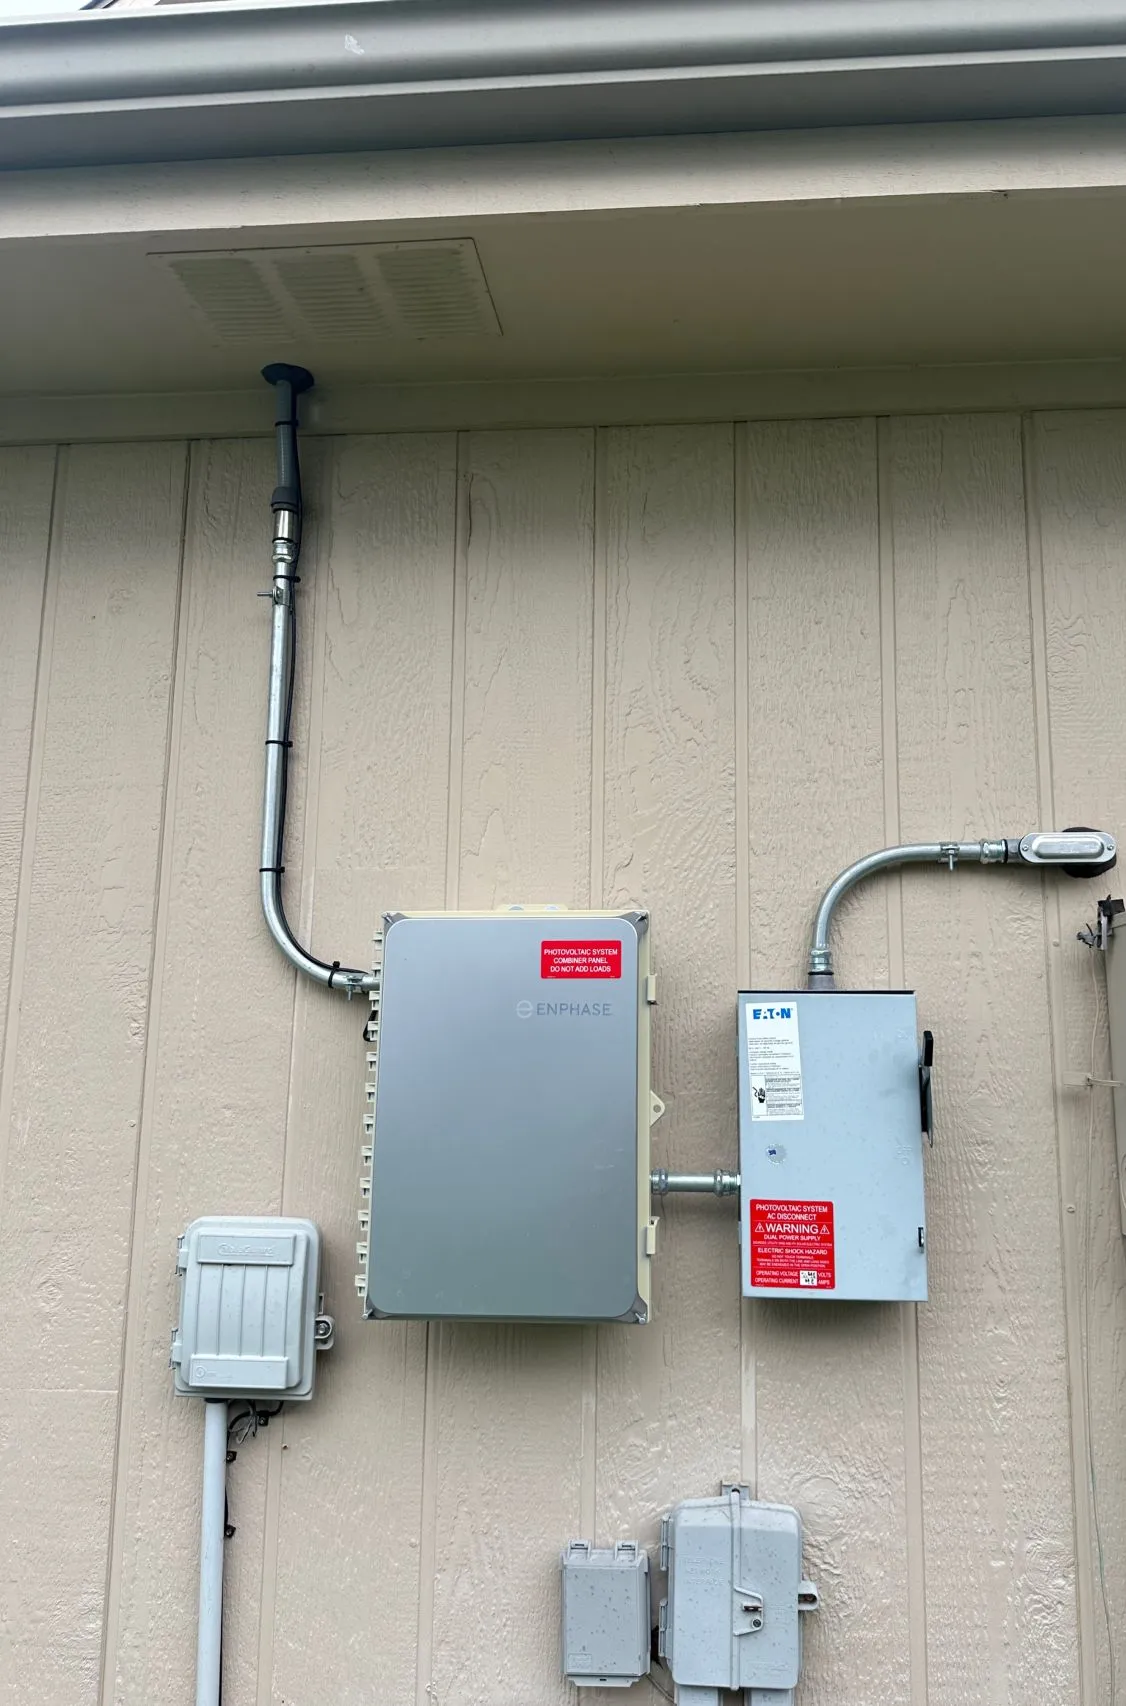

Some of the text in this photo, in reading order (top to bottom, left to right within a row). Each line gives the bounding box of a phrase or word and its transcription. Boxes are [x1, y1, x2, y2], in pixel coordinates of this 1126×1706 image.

[537, 1003, 612, 1016] ENPHASE
[753, 1008, 791, 1019] EATON
[766, 1223, 818, 1234] WARNING
